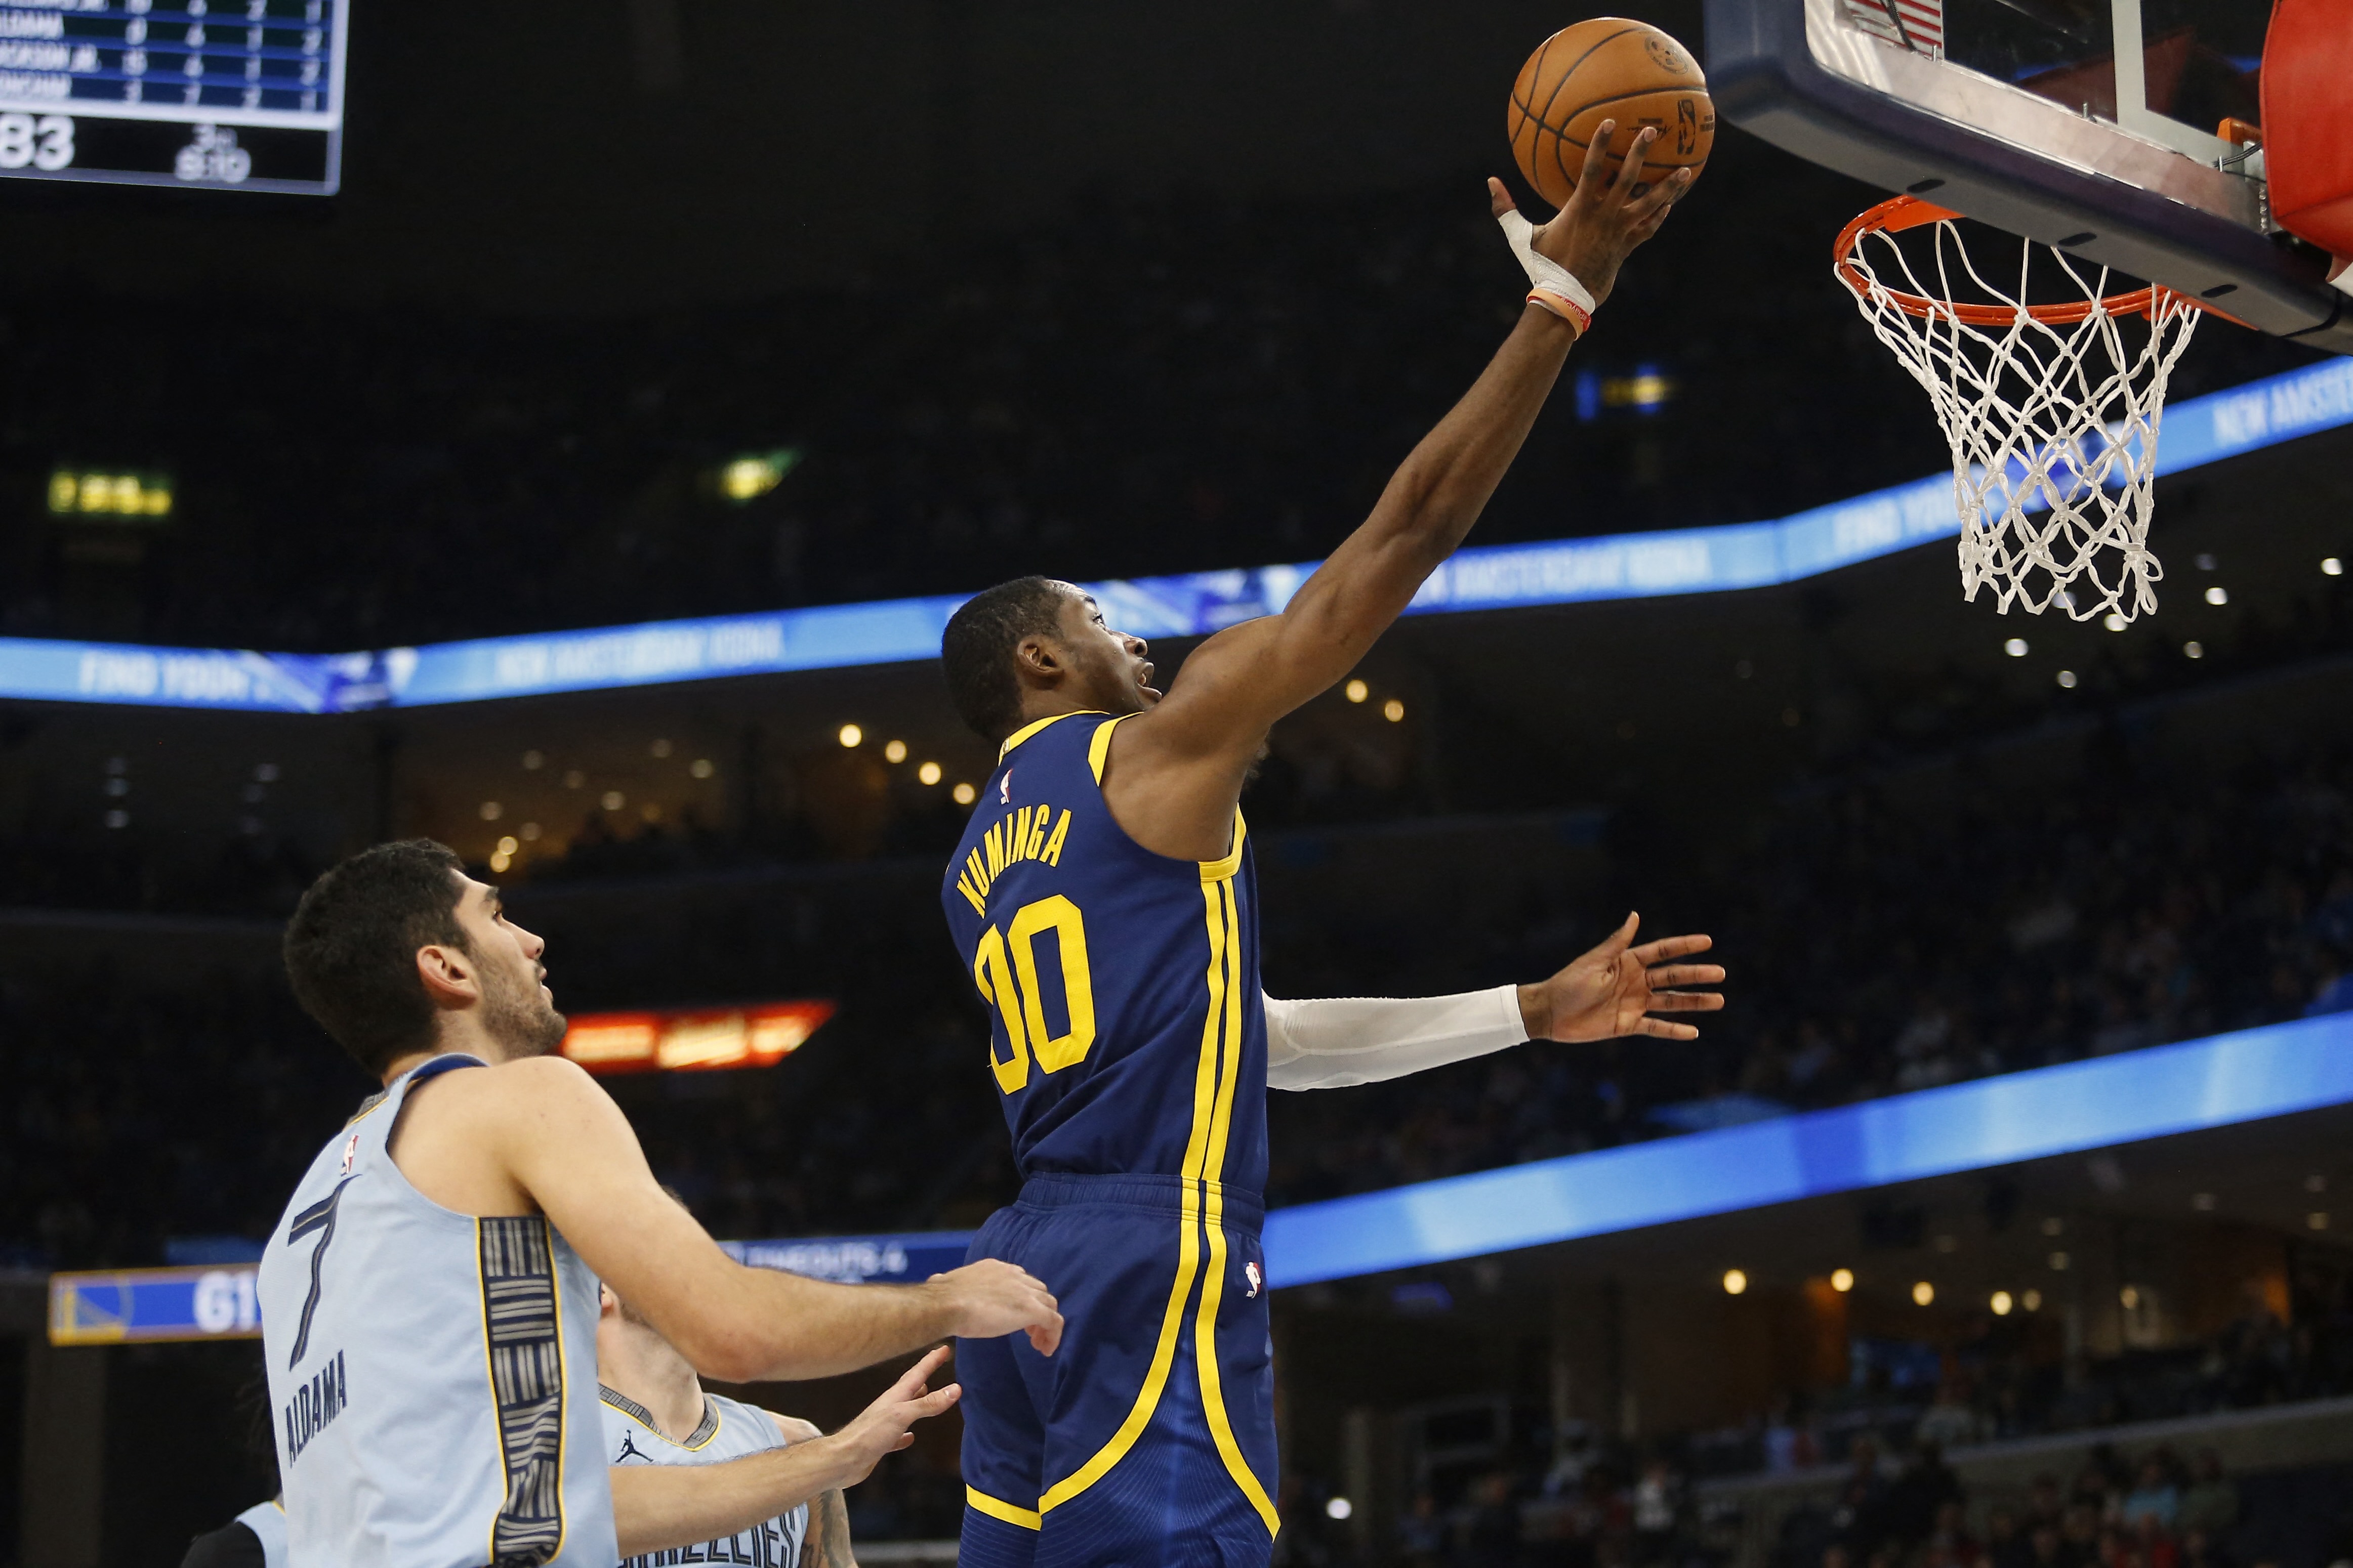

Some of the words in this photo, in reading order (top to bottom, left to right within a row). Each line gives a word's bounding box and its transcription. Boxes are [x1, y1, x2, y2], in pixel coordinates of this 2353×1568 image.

[0, 113, 75, 171] 83
[957, 804, 1077, 919] KUMINGA
[974, 894, 1097, 1095] 00
[287, 1174, 363, 1372] 7
[285, 1348, 348, 1469] ALDAMA
